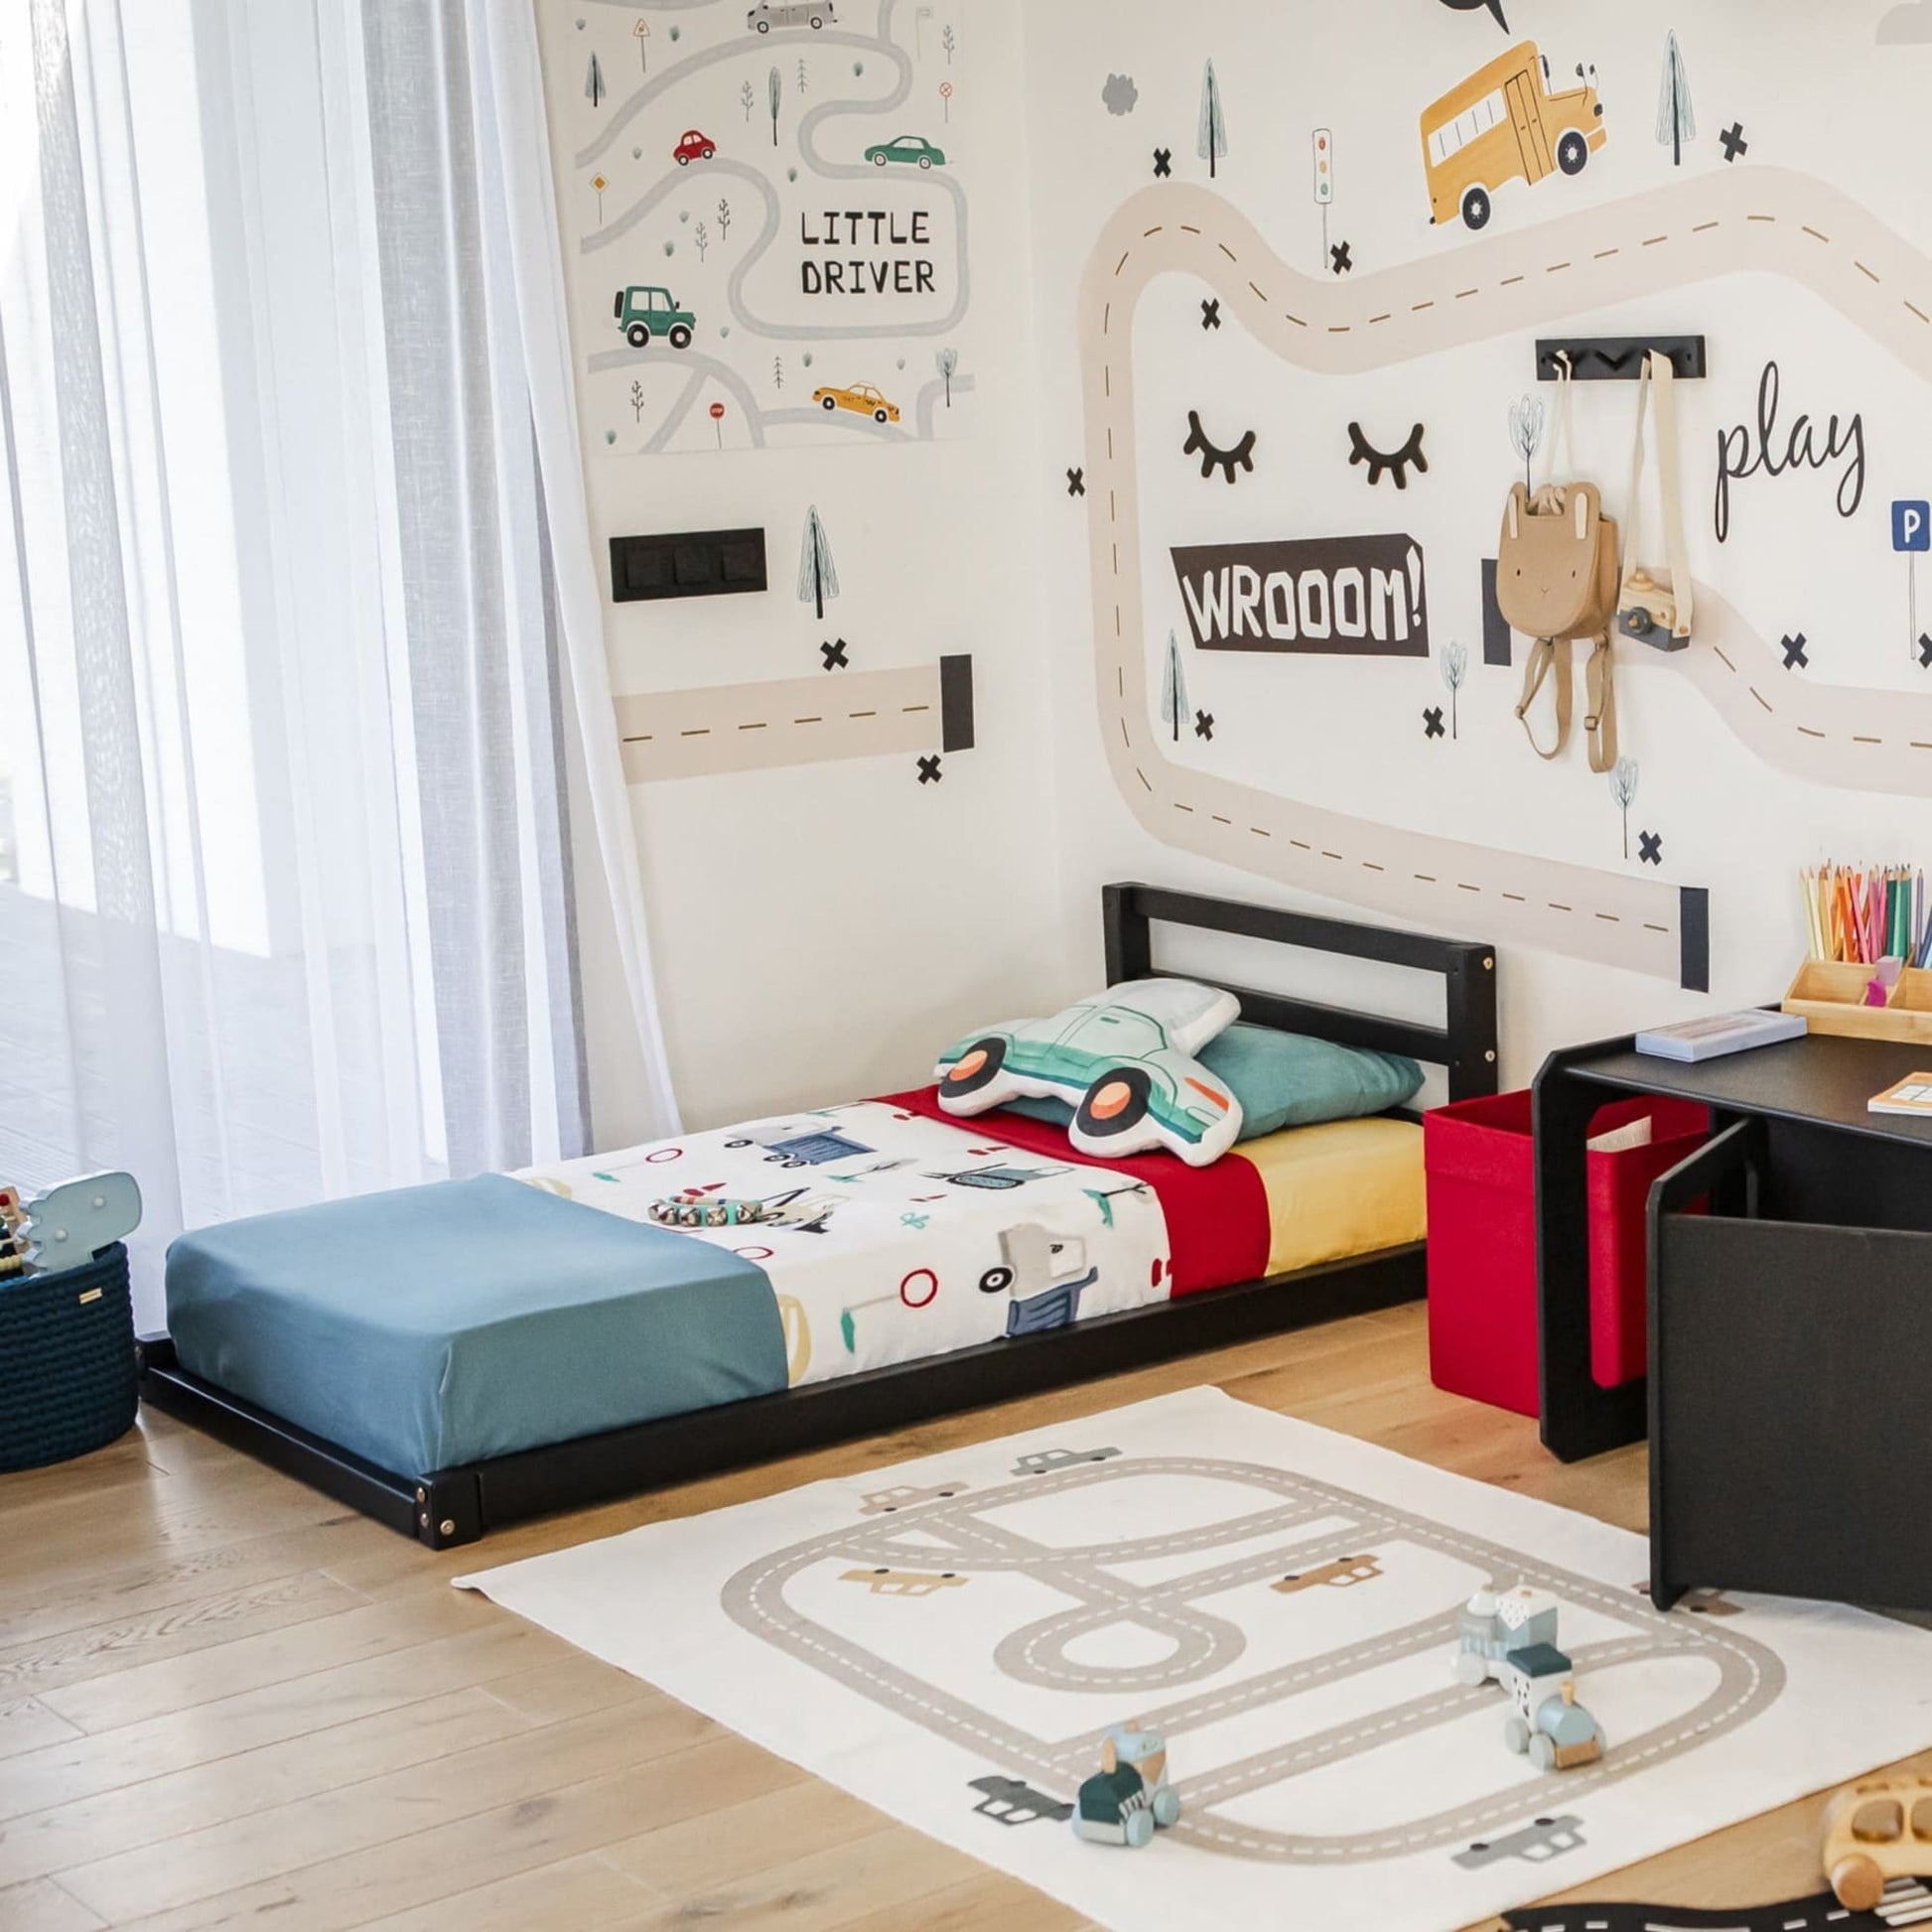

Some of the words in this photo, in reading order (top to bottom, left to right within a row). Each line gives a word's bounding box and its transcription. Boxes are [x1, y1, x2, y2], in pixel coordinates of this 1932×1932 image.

[801, 211, 930, 245] LITTLE
[801, 260, 935, 294] DRIVER
[1715, 360, 1864, 544] play
[1903, 508, 1921, 543] P
[1181, 545, 1422, 642] WROOOM!
